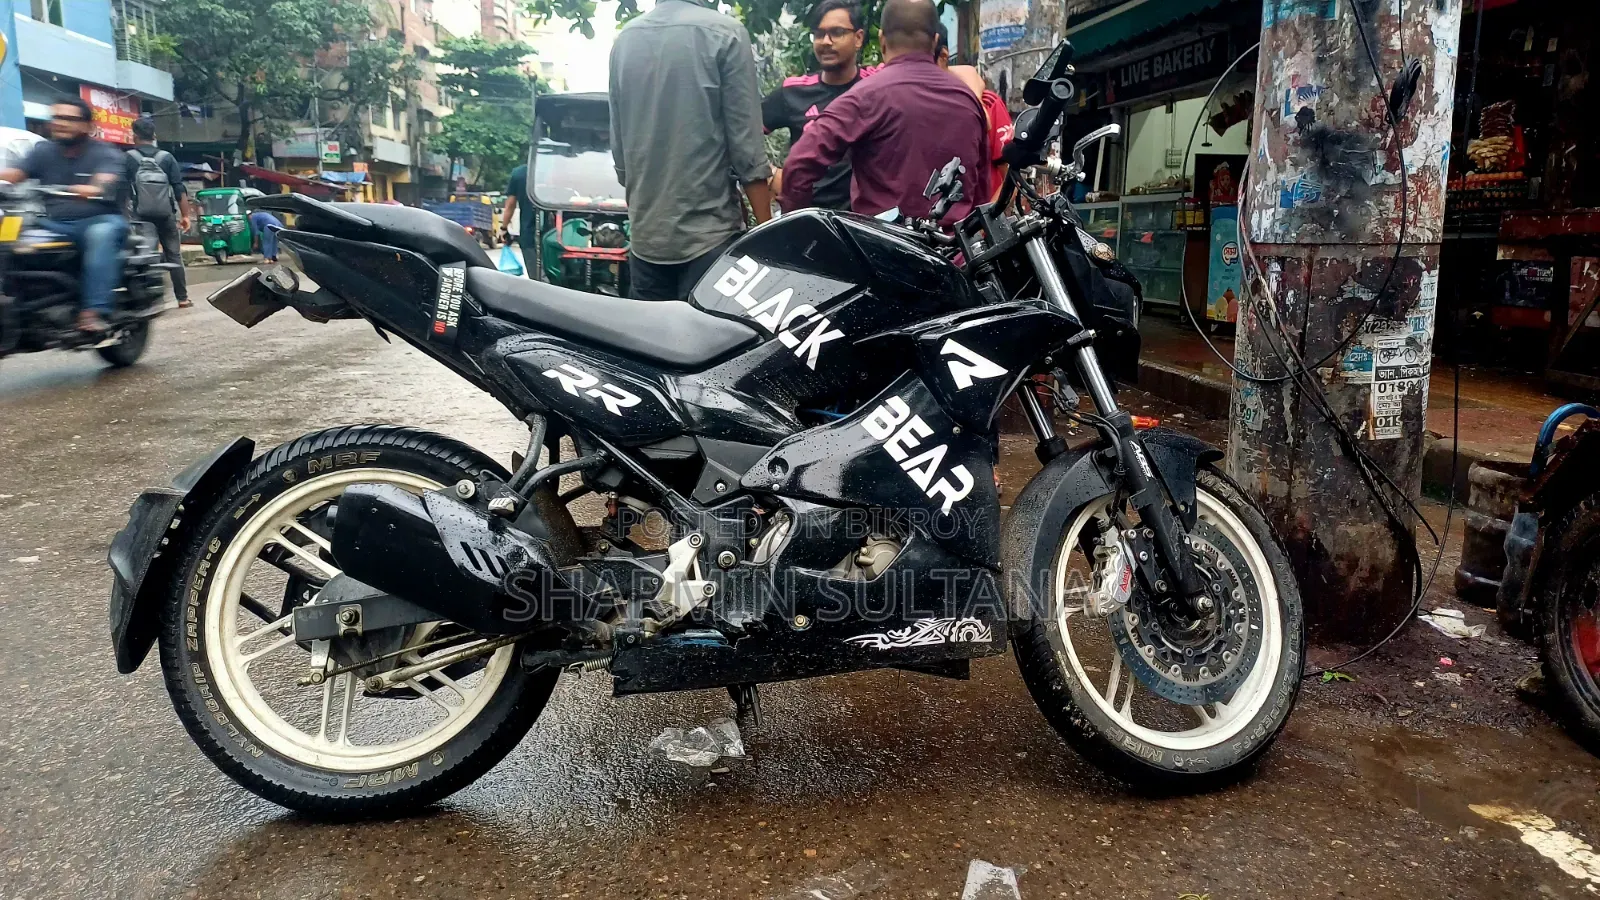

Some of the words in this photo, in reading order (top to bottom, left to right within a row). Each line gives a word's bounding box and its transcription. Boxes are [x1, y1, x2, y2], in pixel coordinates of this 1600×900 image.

[1120, 60, 1150, 87] LIVE
[1153, 37, 1216, 77] BAKERY
[437, 276, 453, 310] ANSWER
[449, 294, 462, 311] YOU
[436, 310, 447, 320] IS
[446, 310, 459, 328] ASK
[712, 254, 846, 371] BLACK
[434, 320, 446, 333] NO
[541, 363, 642, 417] RR
[307, 451, 381, 474] MRF
[860, 395, 975, 516] BEAR
[342, 762, 420, 789] MRF
